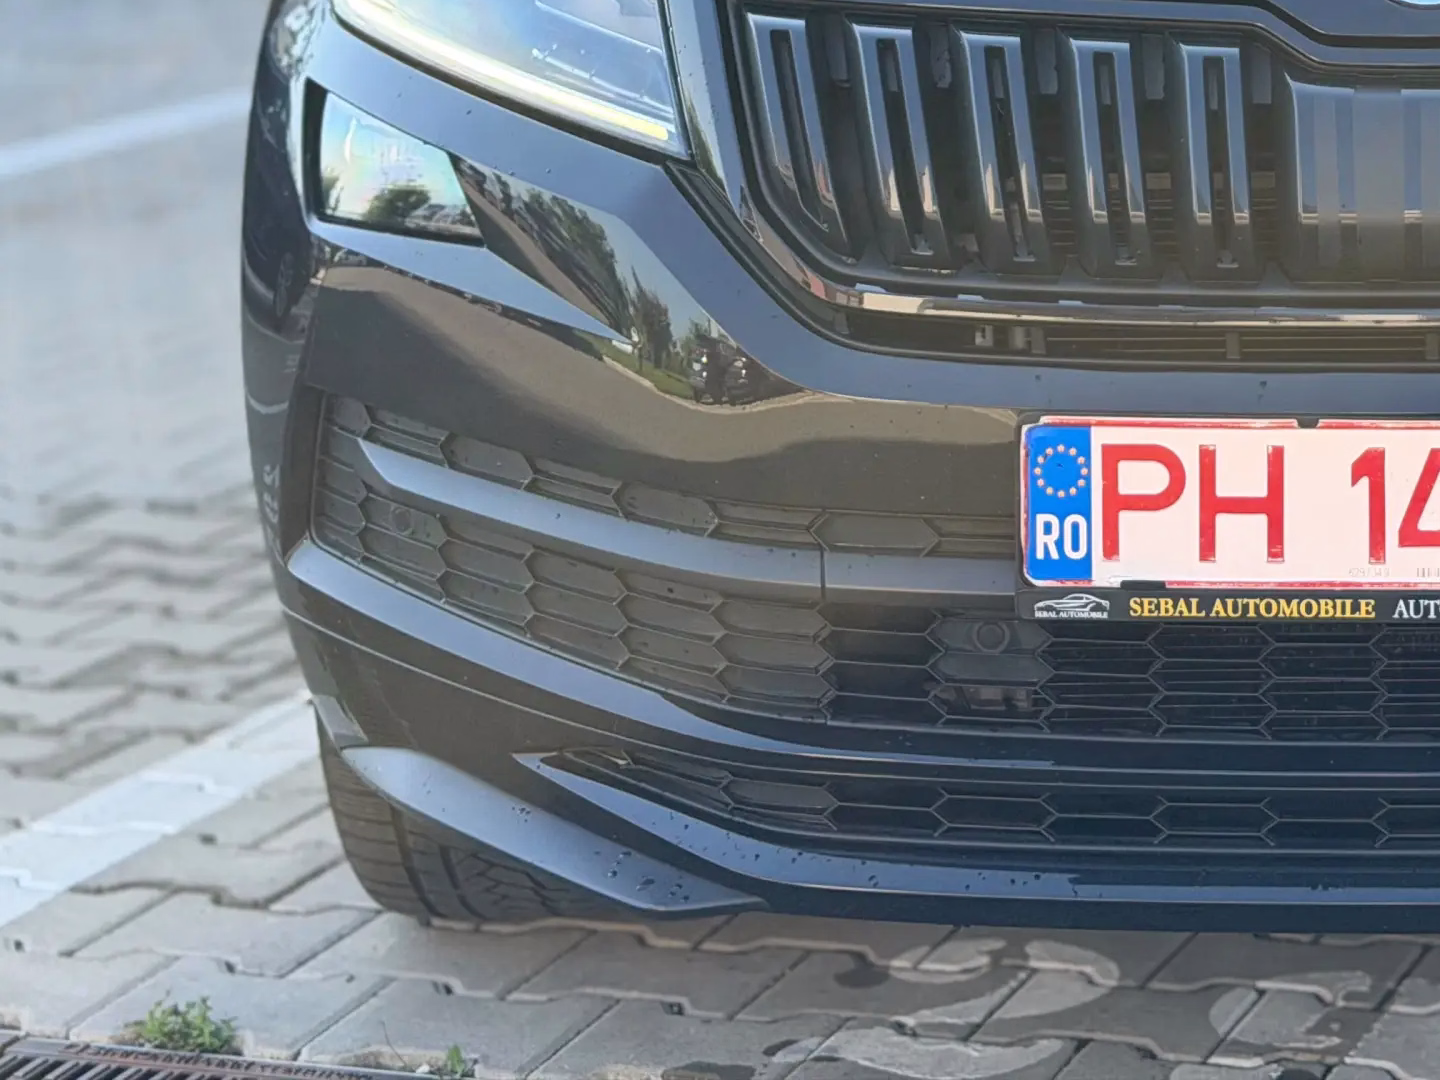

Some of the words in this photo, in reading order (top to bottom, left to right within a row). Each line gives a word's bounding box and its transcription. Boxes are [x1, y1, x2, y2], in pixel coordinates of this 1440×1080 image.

[1101, 443, 1285, 563] PH
[1034, 513, 1089, 560] RO
[1129, 597, 1206, 617] SEBAL
[1210, 598, 1376, 619] AUTOMOBILE
